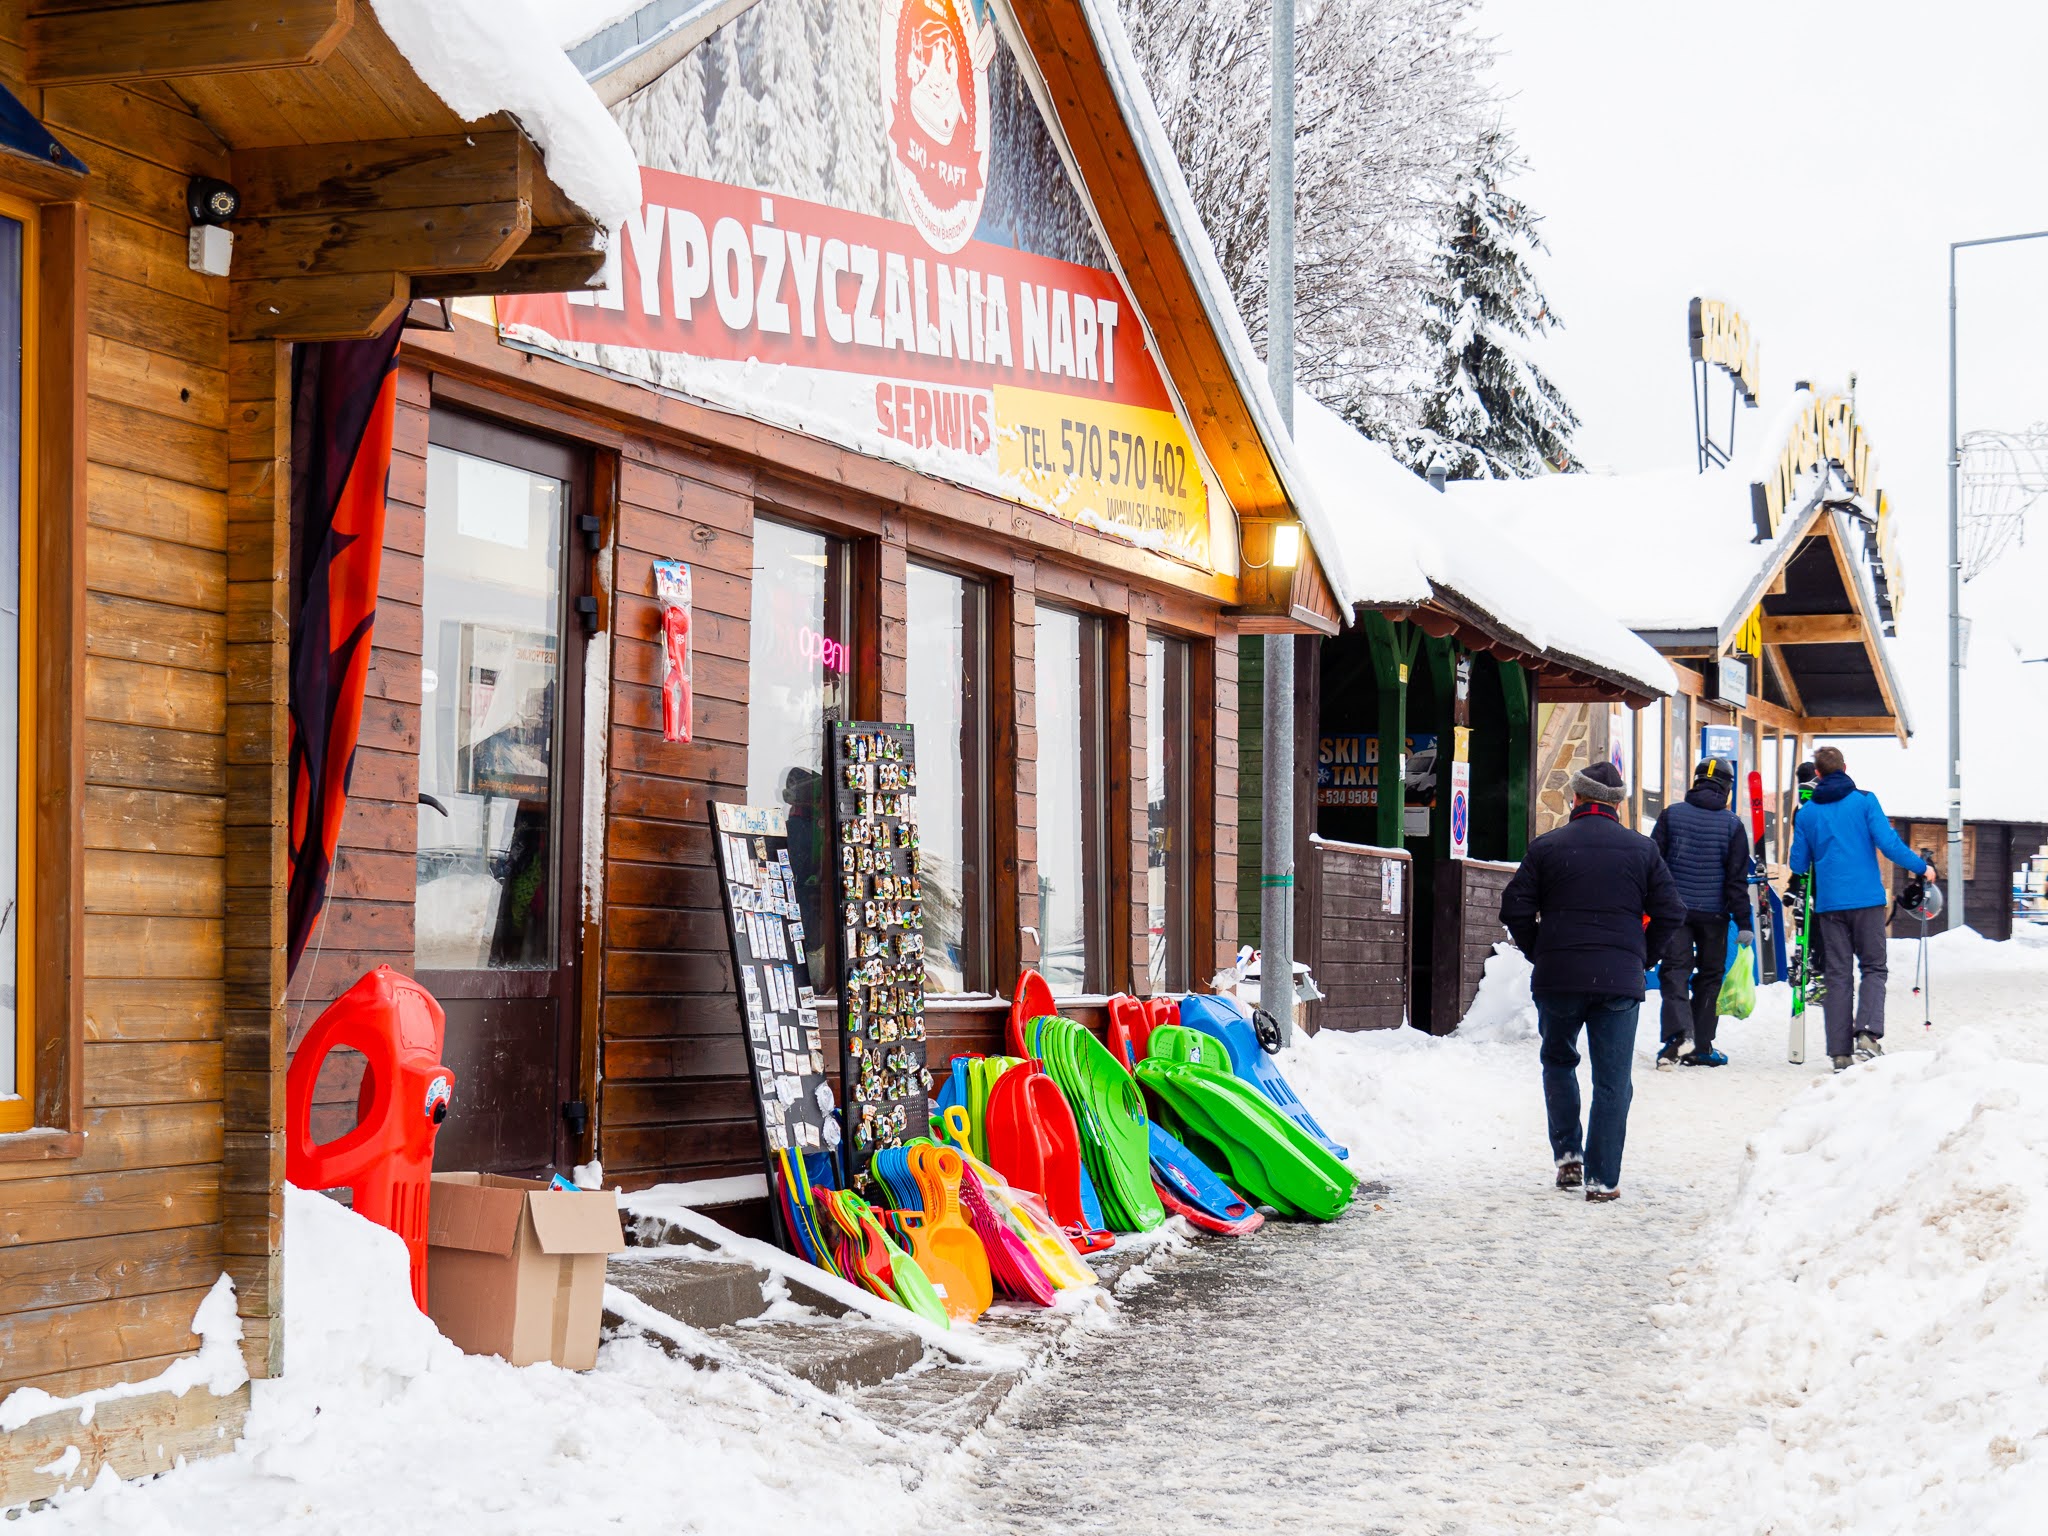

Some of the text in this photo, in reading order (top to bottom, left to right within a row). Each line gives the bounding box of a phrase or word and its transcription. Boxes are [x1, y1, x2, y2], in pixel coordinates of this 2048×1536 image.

[907, 137, 927, 172] SKI
[938, 160, 967, 190] RAFT
[1019, 280, 1119, 384] NART
[875, 381, 992, 456] SERWIS
[1020, 418, 1187, 499] TEL. 570 570 402
[1106, 497, 1189, 536] WWW.SKI-RAFTPL
[1319, 737, 1414, 764] SKI BS
[1326, 790, 1346, 804] 534
[1348, 790, 1369, 804] 958
[1331, 766, 1378, 786] TAXI
